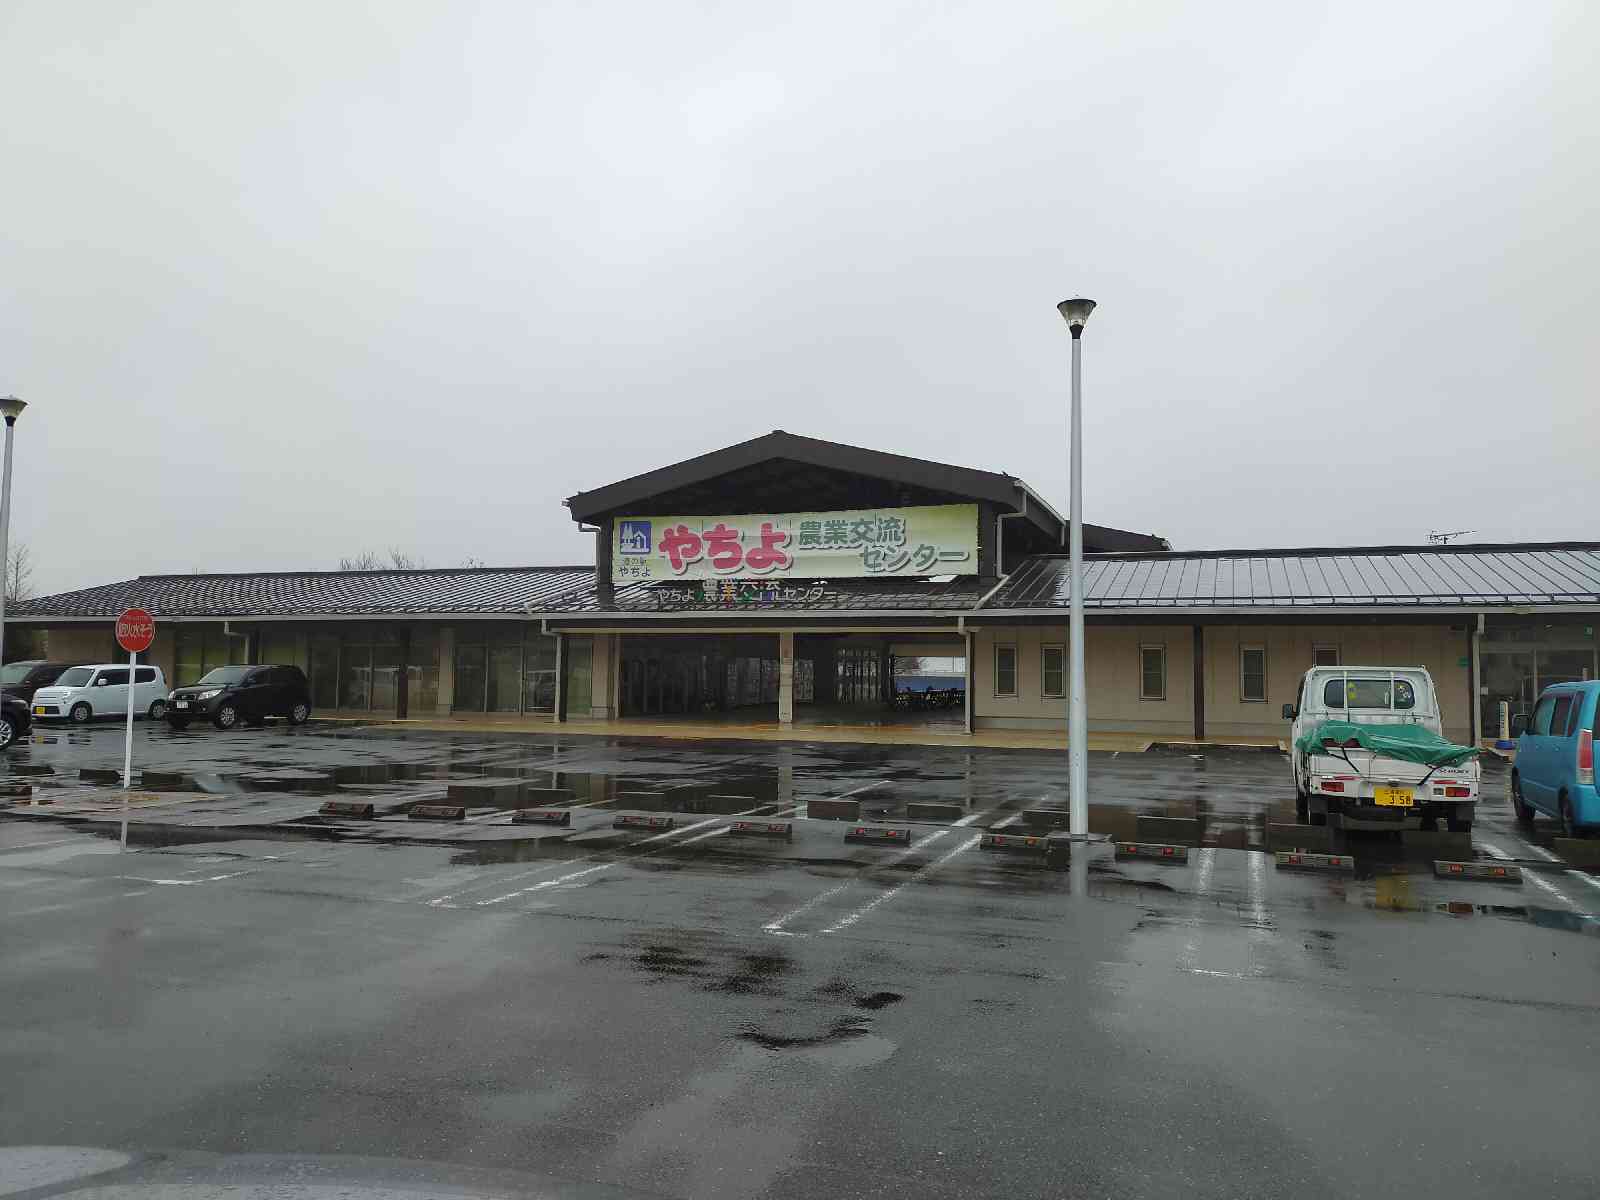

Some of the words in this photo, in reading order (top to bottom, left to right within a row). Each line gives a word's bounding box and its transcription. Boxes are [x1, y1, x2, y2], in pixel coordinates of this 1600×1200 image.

[799, 517, 905, 547] 農業交流
[658, 522, 791, 574] やちよ
[863, 544, 969, 571] センター
[618, 566, 651, 577] やちよ
